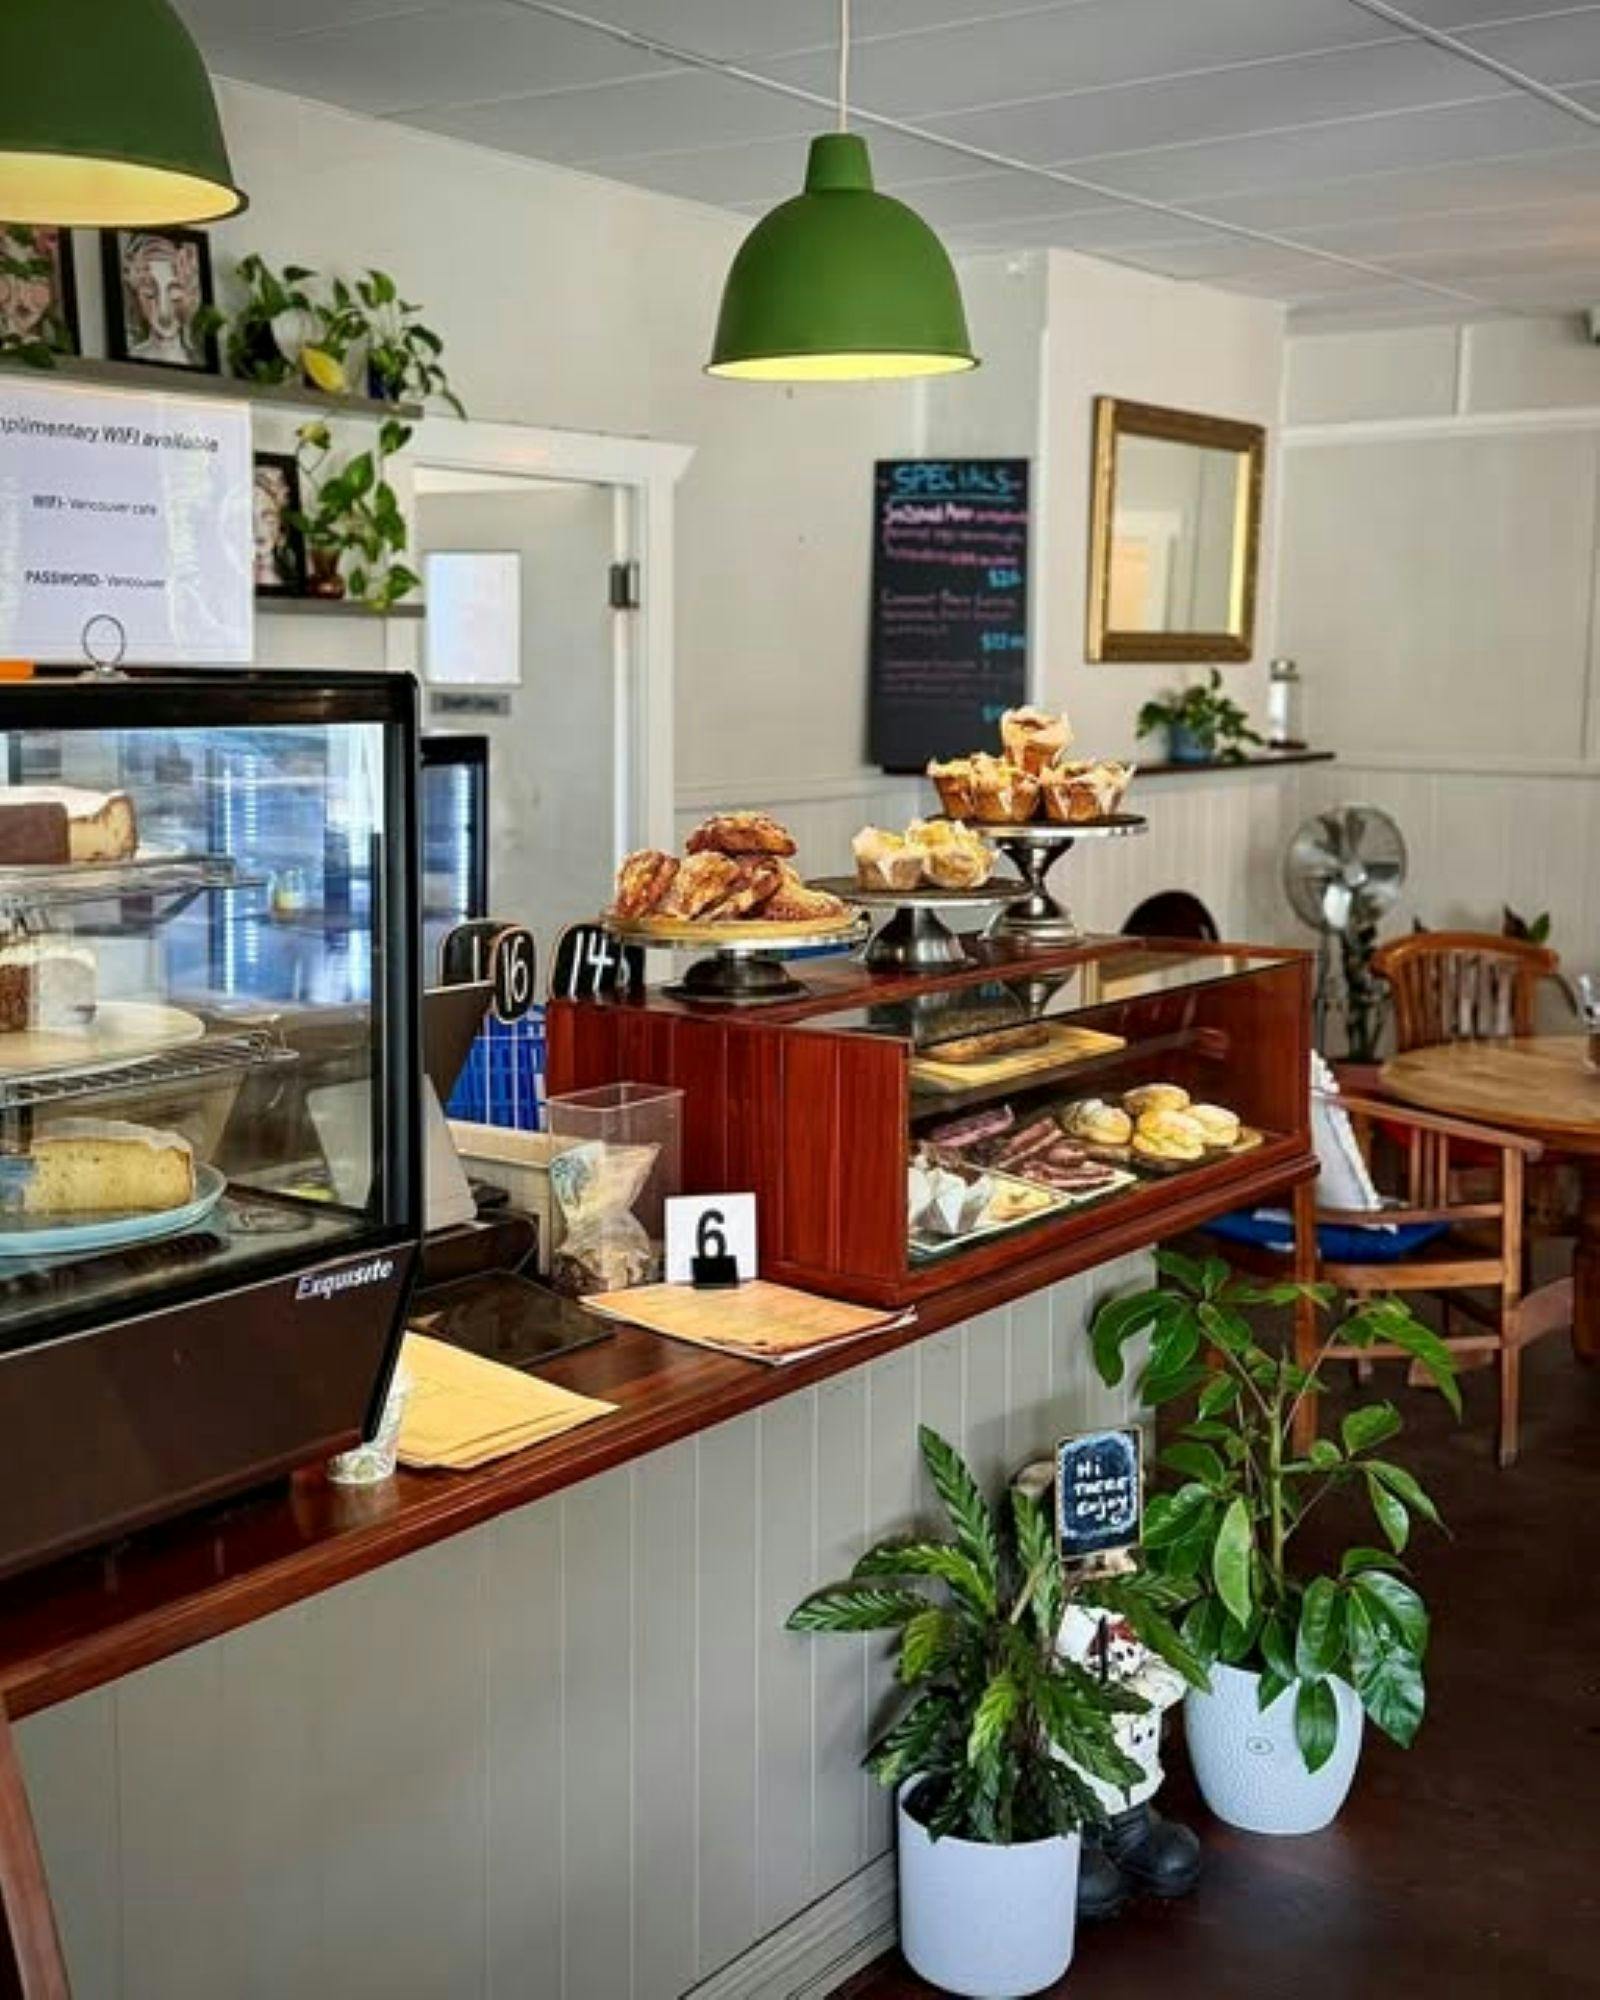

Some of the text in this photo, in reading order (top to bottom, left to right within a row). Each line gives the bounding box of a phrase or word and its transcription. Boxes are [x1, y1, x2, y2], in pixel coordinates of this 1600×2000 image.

[103, 426, 140, 446] WIFI
[142, 432, 218, 453] available
[502, 935, 528, 1012] 16
[696, 1207, 727, 1258] 6
[295, 1258, 394, 1300] Exquisite
[1076, 1455, 1100, 1477] Hi
